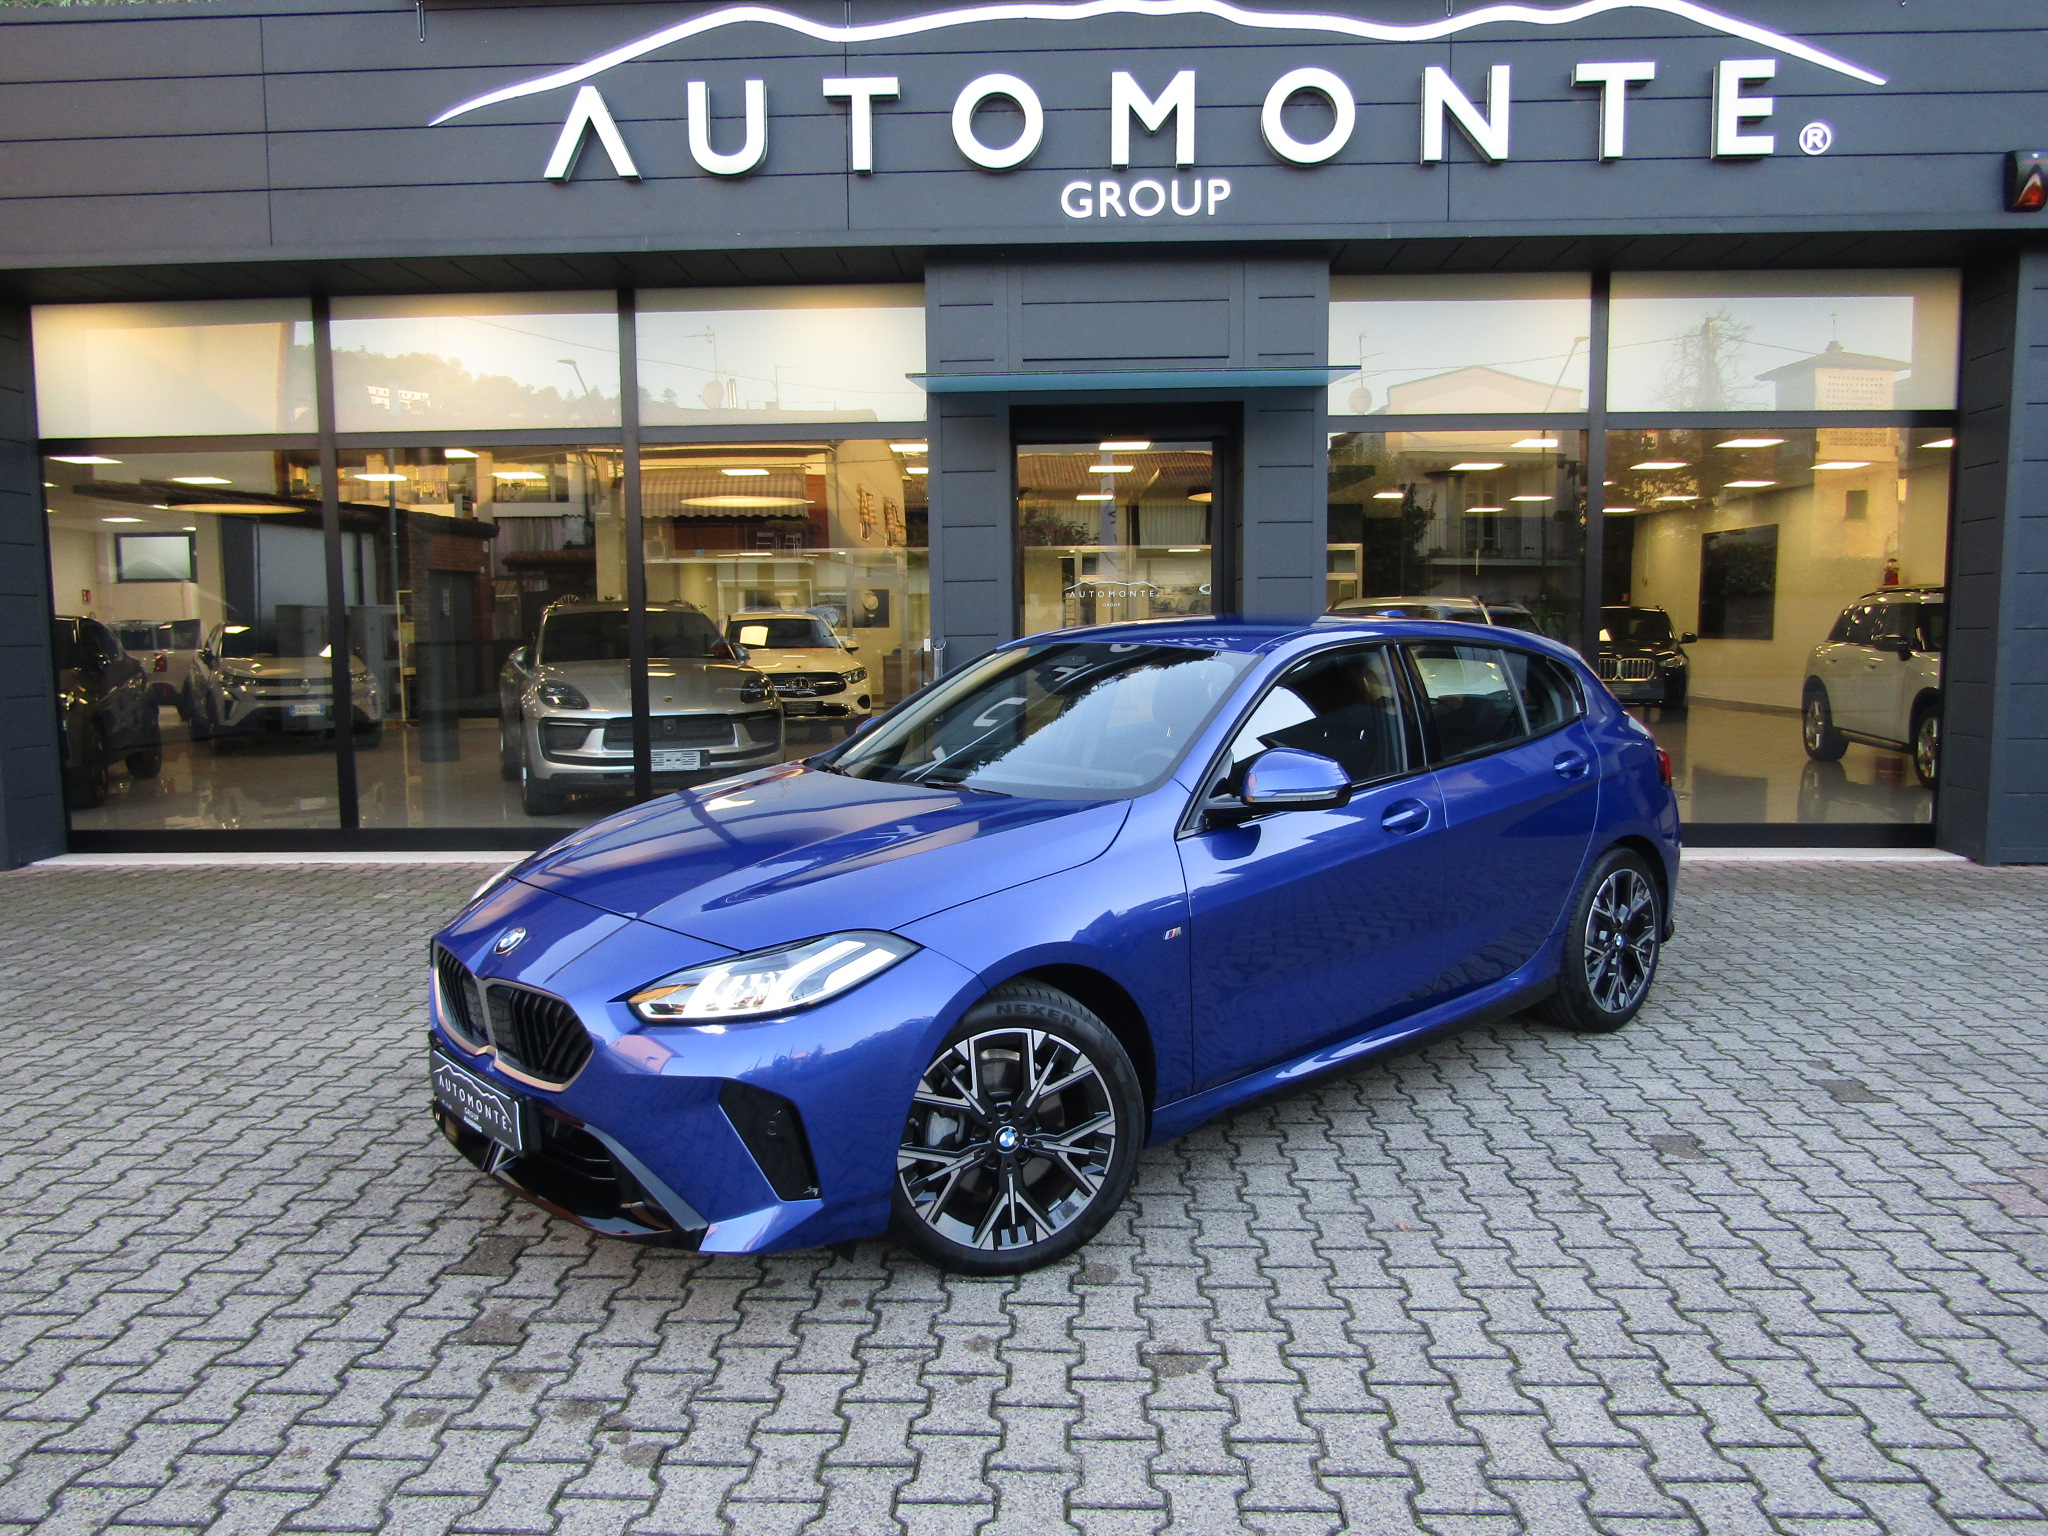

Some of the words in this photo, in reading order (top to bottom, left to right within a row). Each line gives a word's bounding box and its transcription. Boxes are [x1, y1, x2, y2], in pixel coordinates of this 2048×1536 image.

[543, 58, 1777, 181] AUTOMONTE
[1060, 179, 1231, 219] GROUP
[1069, 590, 1155, 598] AUTOMONTE
[996, 1003, 1077, 1027] NEXEN
[439, 1074, 508, 1130] AUTOMONTE
